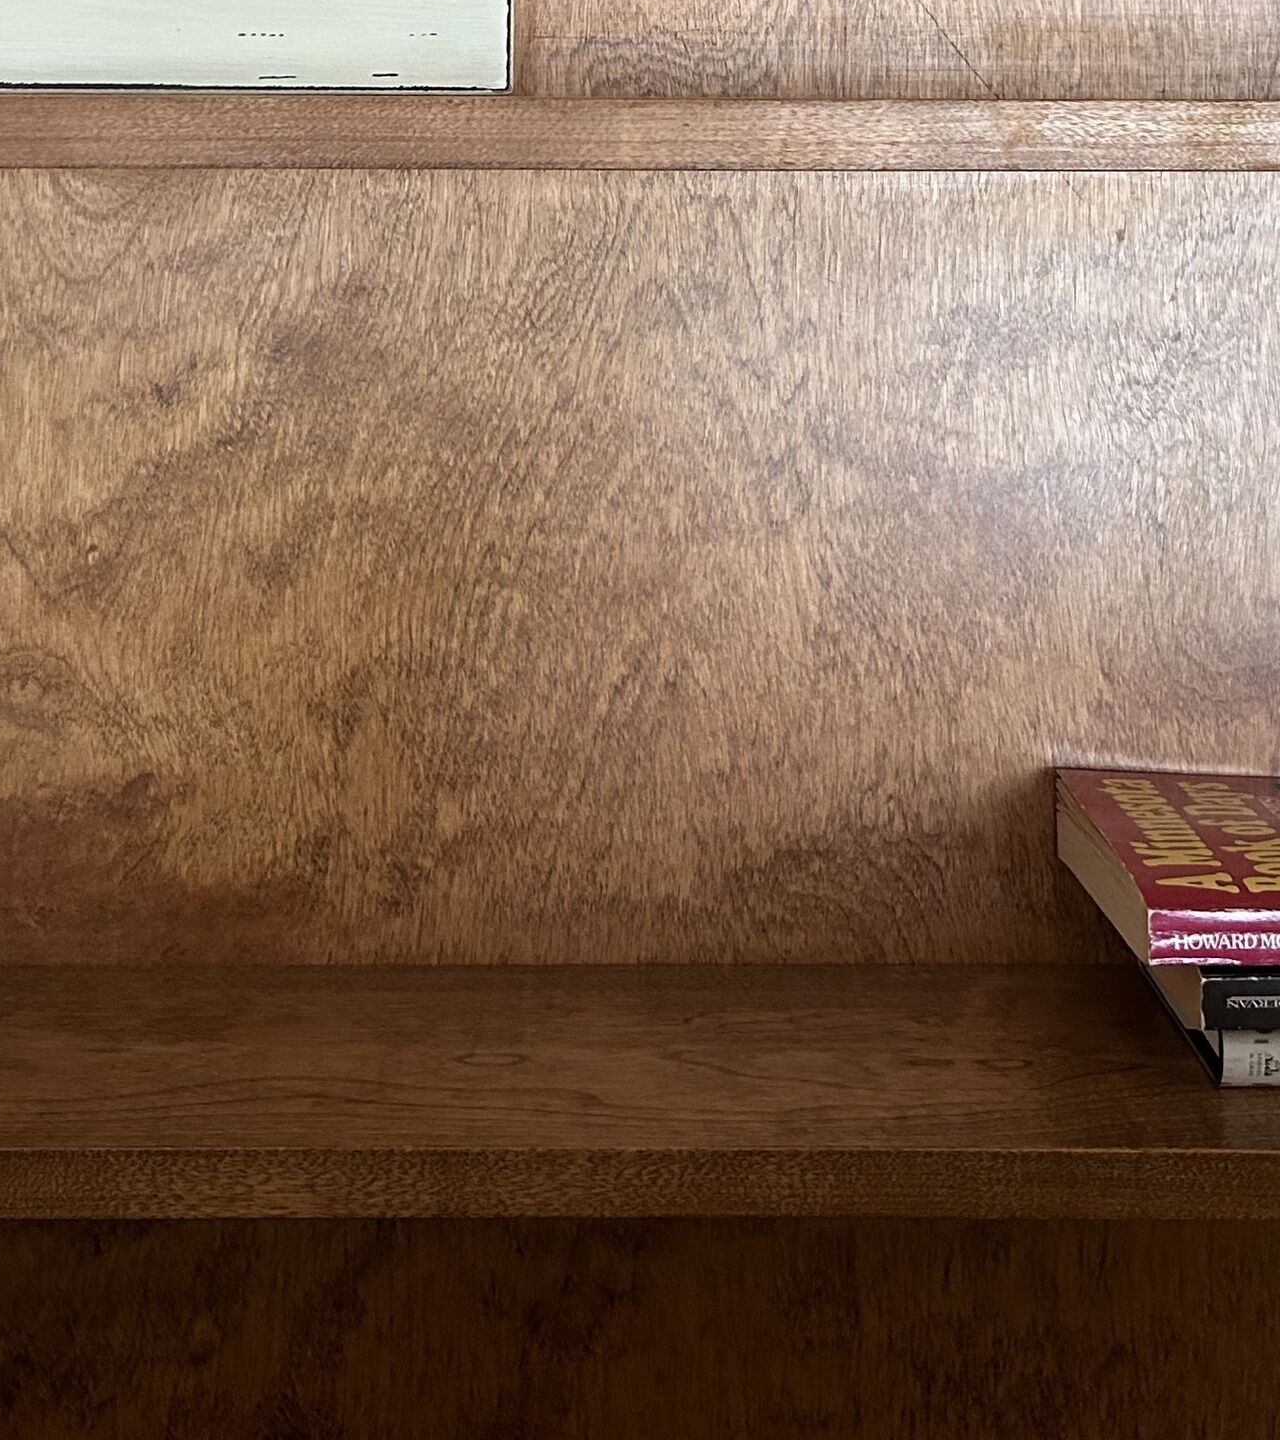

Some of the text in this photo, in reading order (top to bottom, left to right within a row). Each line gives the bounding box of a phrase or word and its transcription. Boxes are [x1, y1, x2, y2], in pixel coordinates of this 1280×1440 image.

[1176, 781, 1258, 817] Days
[1099, 778, 1241, 895] A Minnesota
[1197, 820, 1277, 836] of
[1174, 933, 1259, 950] HOWARD
